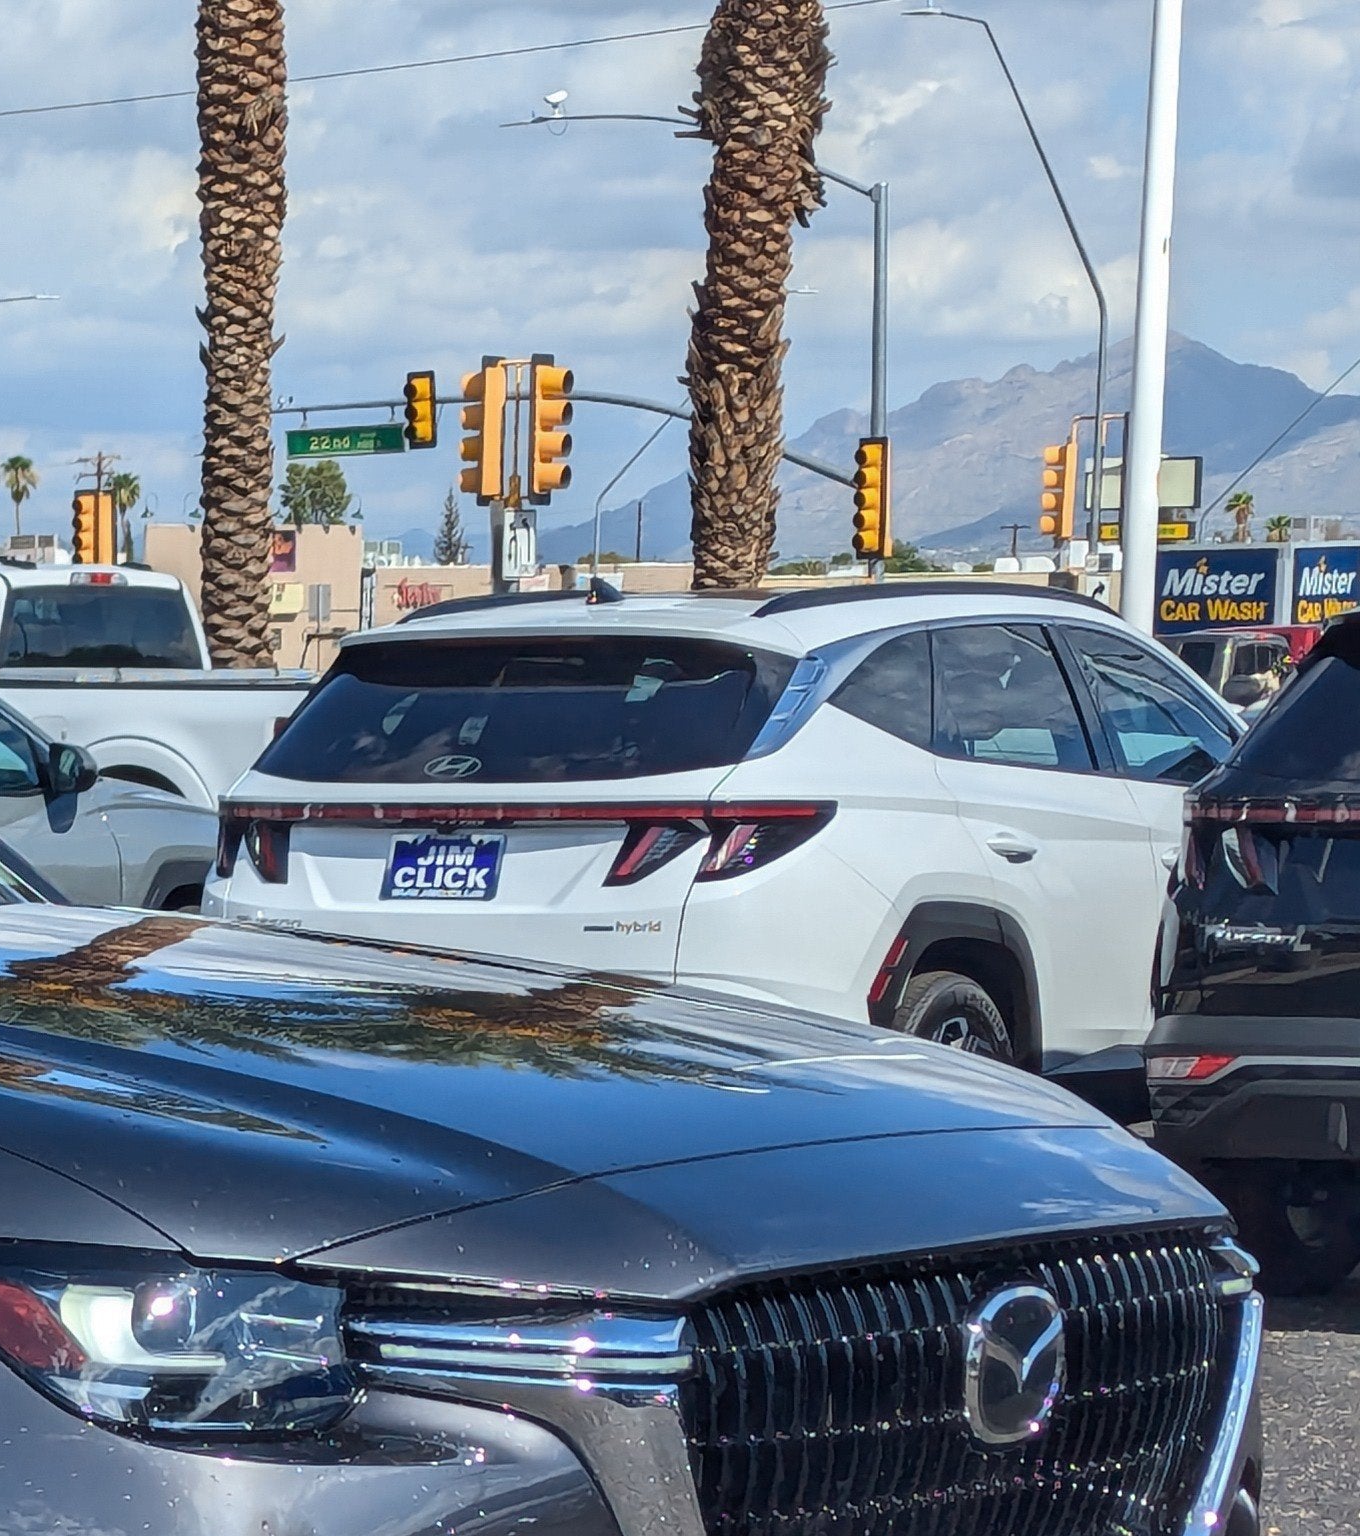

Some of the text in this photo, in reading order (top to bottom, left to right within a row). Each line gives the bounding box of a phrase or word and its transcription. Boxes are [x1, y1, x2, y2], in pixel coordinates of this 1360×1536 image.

[1162, 569, 1265, 596] Mister
[1299, 566, 1356, 596] Mister
[1161, 599, 1266, 621] CAR WASH
[417, 845, 476, 866] JIM
[394, 866, 490, 888] CLICK
[616, 920, 662, 935] hybrid
